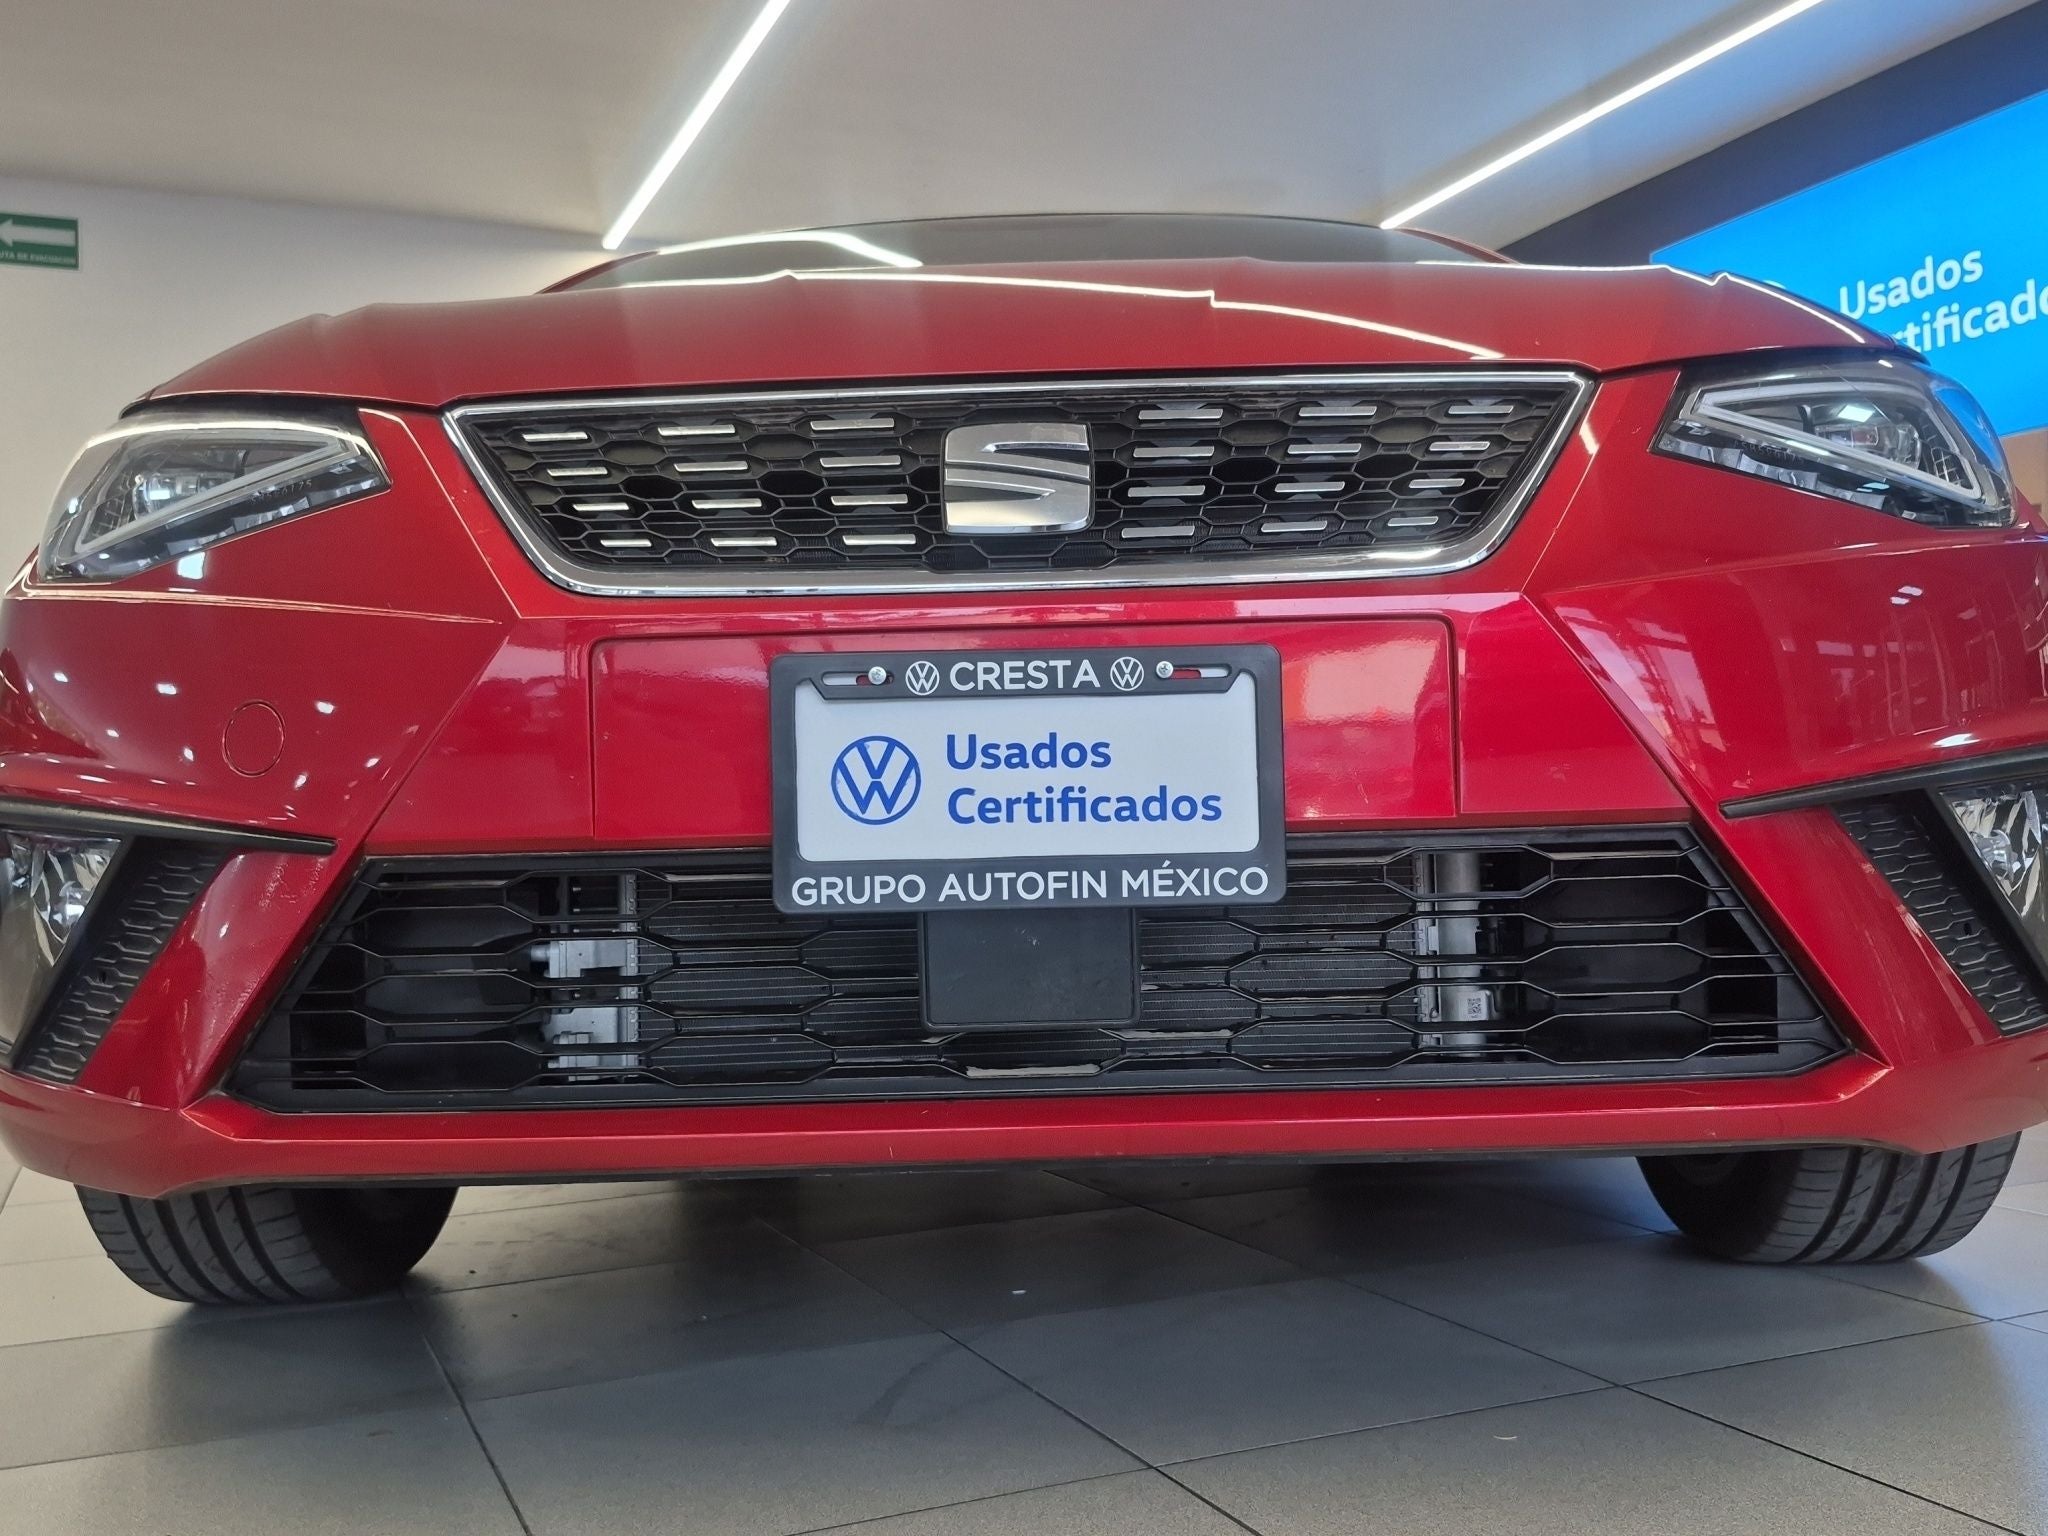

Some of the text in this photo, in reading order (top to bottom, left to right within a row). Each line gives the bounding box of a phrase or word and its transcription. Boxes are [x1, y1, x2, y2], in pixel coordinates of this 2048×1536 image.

[1840, 250, 1983, 320] Usados
[950, 660, 1101, 691] CRESTA
[947, 732, 1112, 770] Usados
[948, 785, 1222, 825] Certificados
[792, 861, 1268, 906] GRUPO AUTOFIN MÉXICO
